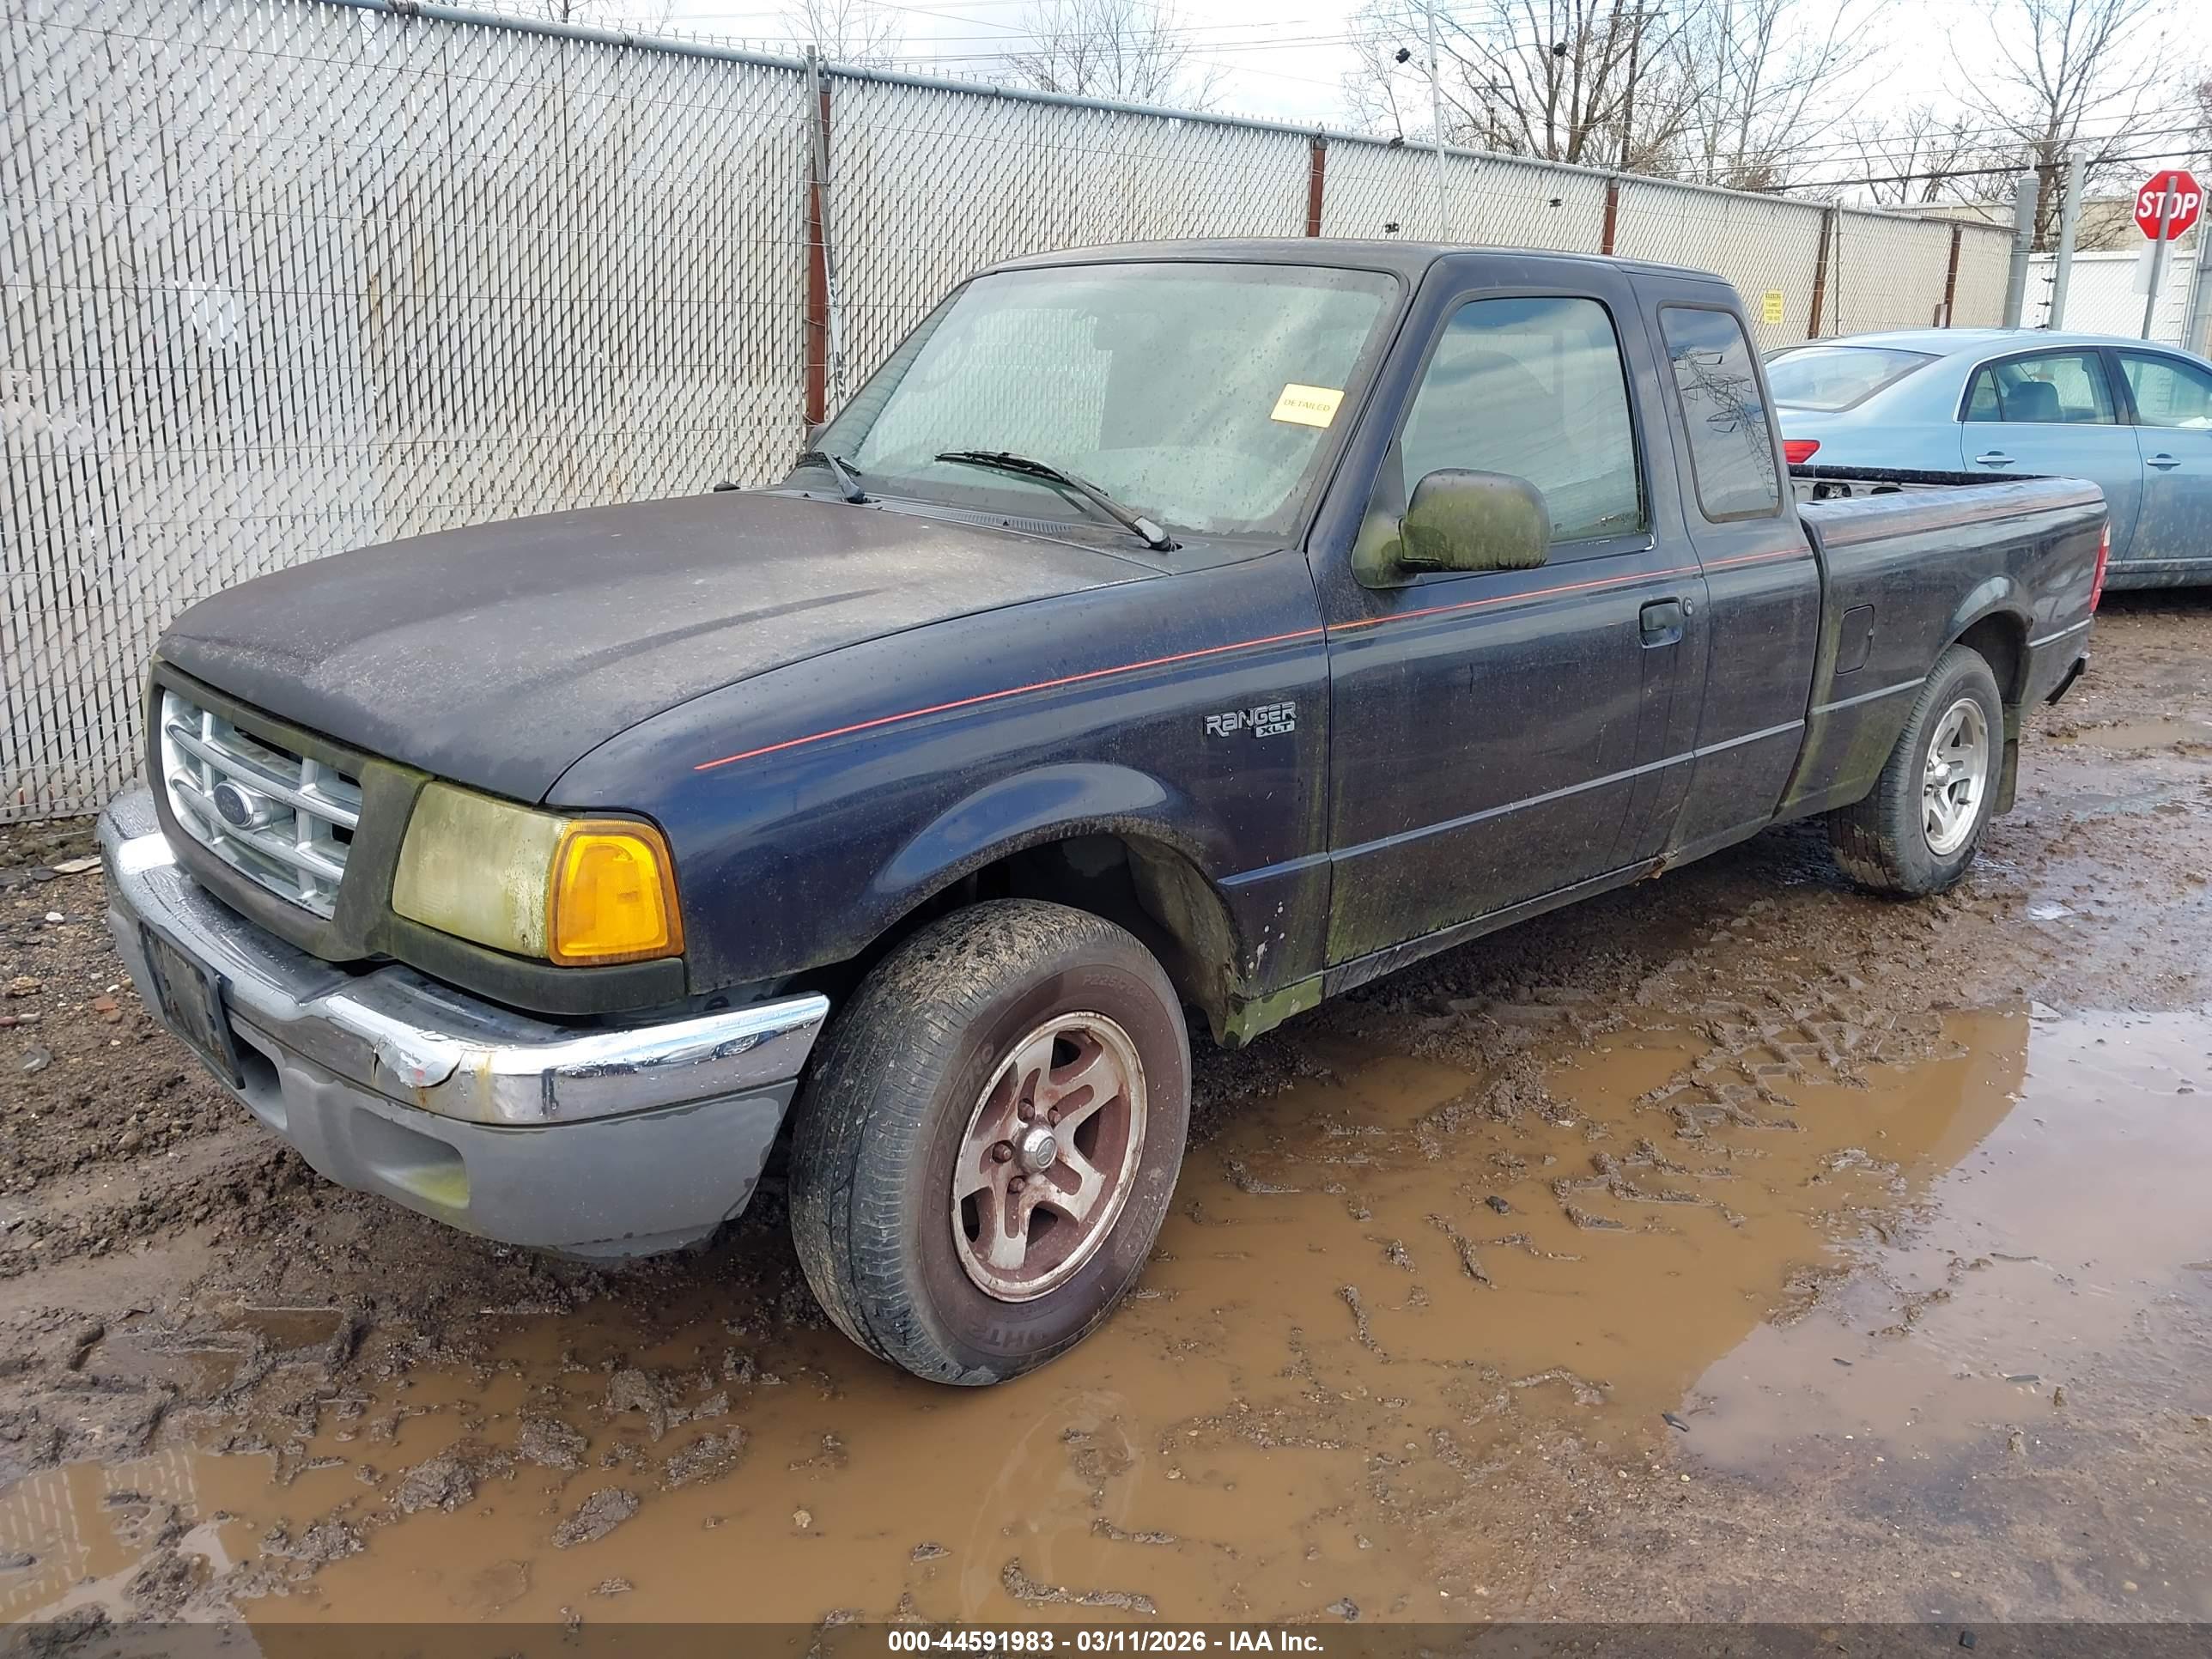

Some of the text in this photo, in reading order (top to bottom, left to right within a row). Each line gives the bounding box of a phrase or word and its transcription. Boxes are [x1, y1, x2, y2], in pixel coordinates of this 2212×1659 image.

[2138, 191, 2198, 220] STOP
[1283, 398, 1331, 412] DETAILED
[1204, 702, 1297, 738] RANGER
[1260, 721, 1291, 736] XLT
